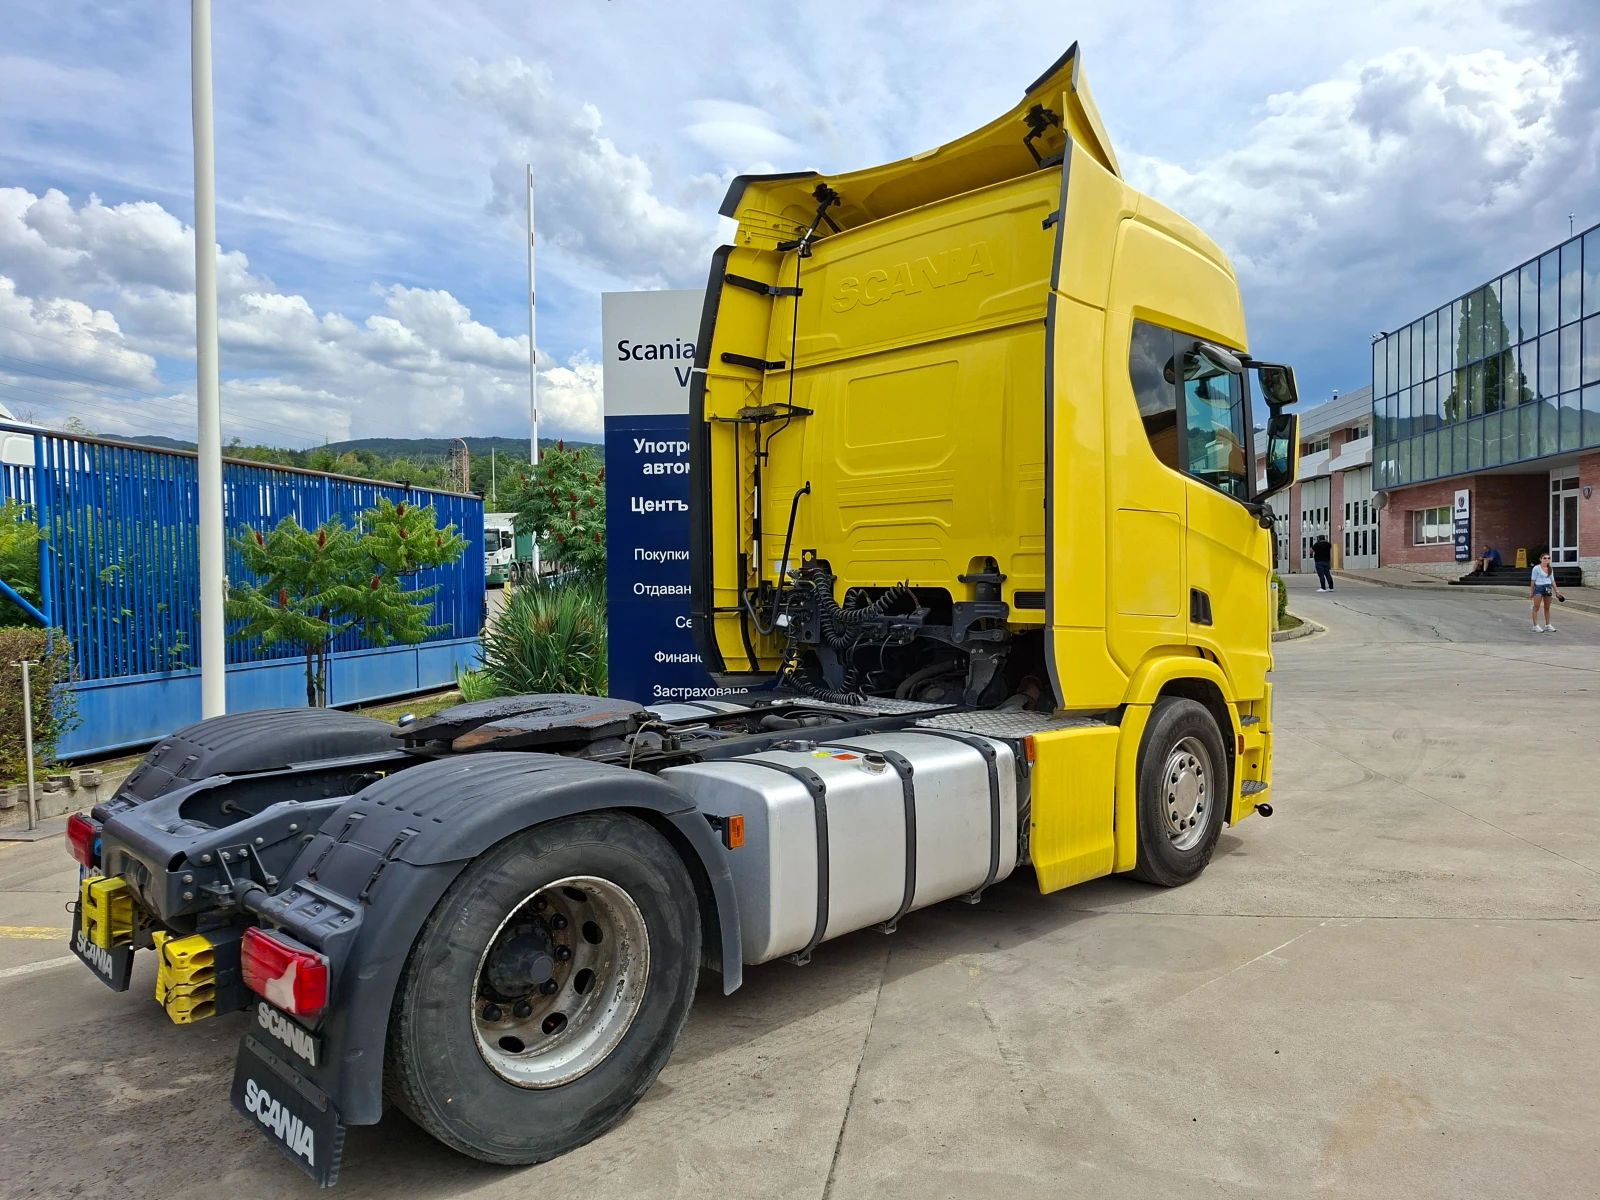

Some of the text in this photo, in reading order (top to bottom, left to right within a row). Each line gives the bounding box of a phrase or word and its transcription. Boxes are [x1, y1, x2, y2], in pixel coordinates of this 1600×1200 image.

[831, 241, 995, 313] SCANIA
[617, 338, 696, 361] Scania
[633, 438, 690, 456] Употр
[631, 496, 689, 514] Центъ
[634, 548, 690, 563] Покупки
[633, 582, 692, 597] Отдаван
[675, 615, 692, 629] Се
[76, 930, 113, 980] SCANIA
[257, 1001, 316, 1067] SCANIA
[244, 1078, 315, 1167] SCANIA
